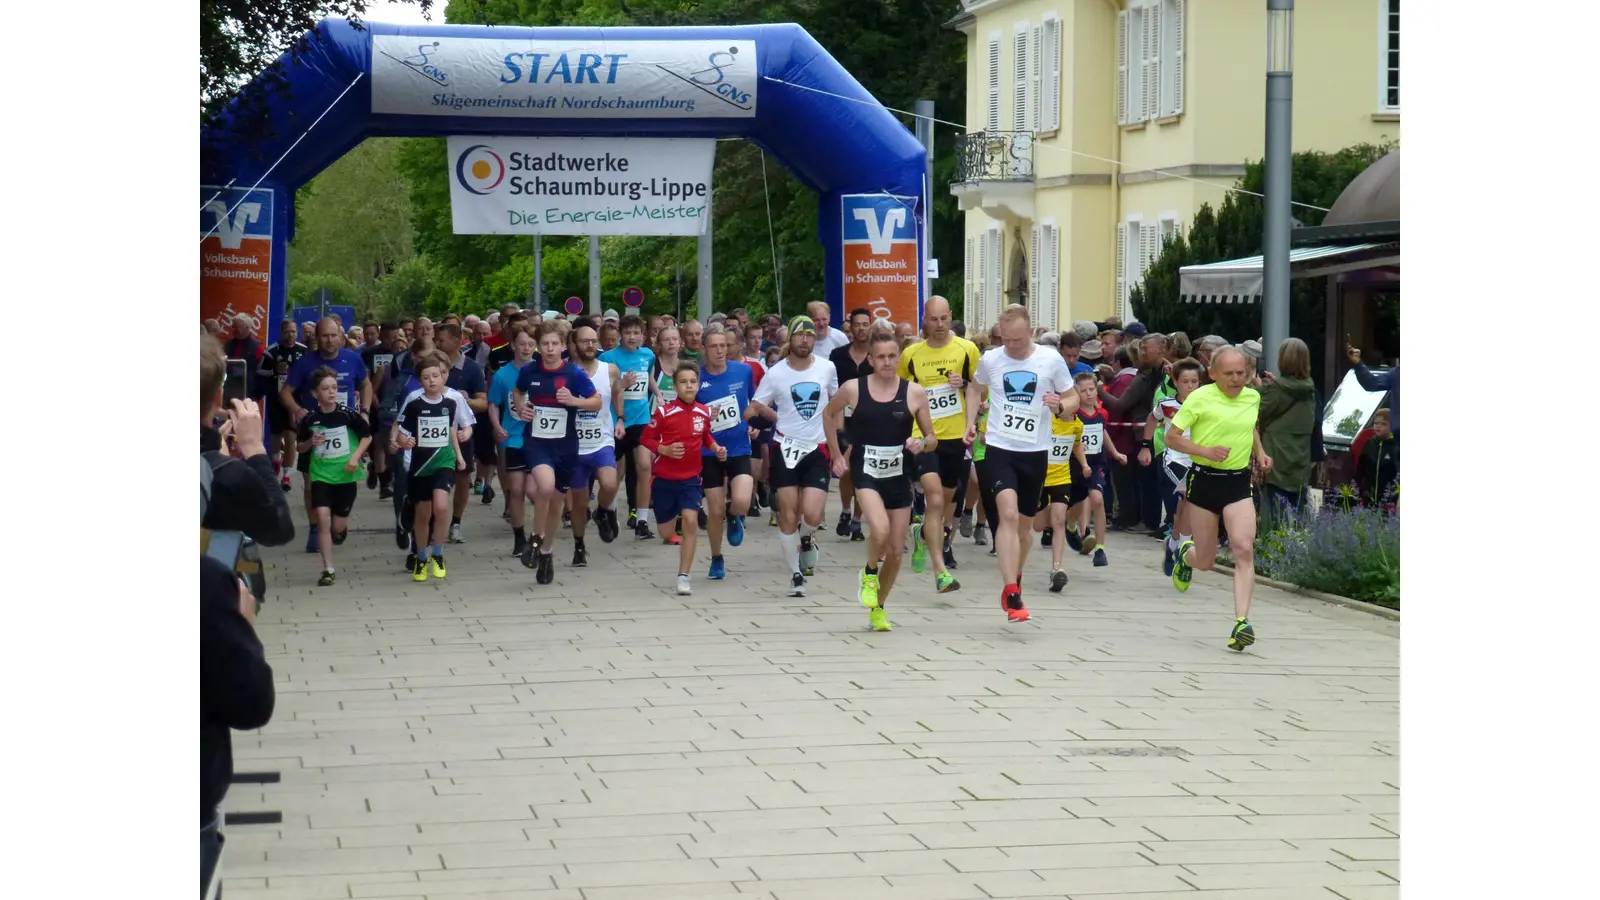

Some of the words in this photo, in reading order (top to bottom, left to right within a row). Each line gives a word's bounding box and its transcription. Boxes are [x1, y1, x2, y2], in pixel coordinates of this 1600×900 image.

[500, 52, 628, 84] START
[431, 93, 557, 111] Skigemeinschaft
[560, 95, 696, 112] Nordschaumburg
[509, 151, 629, 172] Stadtwerke
[509, 176, 707, 201] Schaumburg-Lippe
[507, 209, 539, 226] Die
[545, 204, 706, 224] Energie-Meister
[204, 253, 259, 265] Volksbank
[856, 259, 908, 269] Volksbank
[203, 267, 269, 282] Schaumburg
[845, 273, 854, 284] in
[856, 272, 917, 286] Schaumburg
[928, 393, 958, 410] 365
[539, 418, 559, 430] 97
[1003, 414, 1036, 432] 376
[421, 427, 448, 439] 284
[576, 428, 602, 440] 355
[324, 437, 342, 450] 76
[1081, 434, 1098, 446] 83
[1051, 445, 1069, 457] 82
[868, 457, 900, 470] 354
